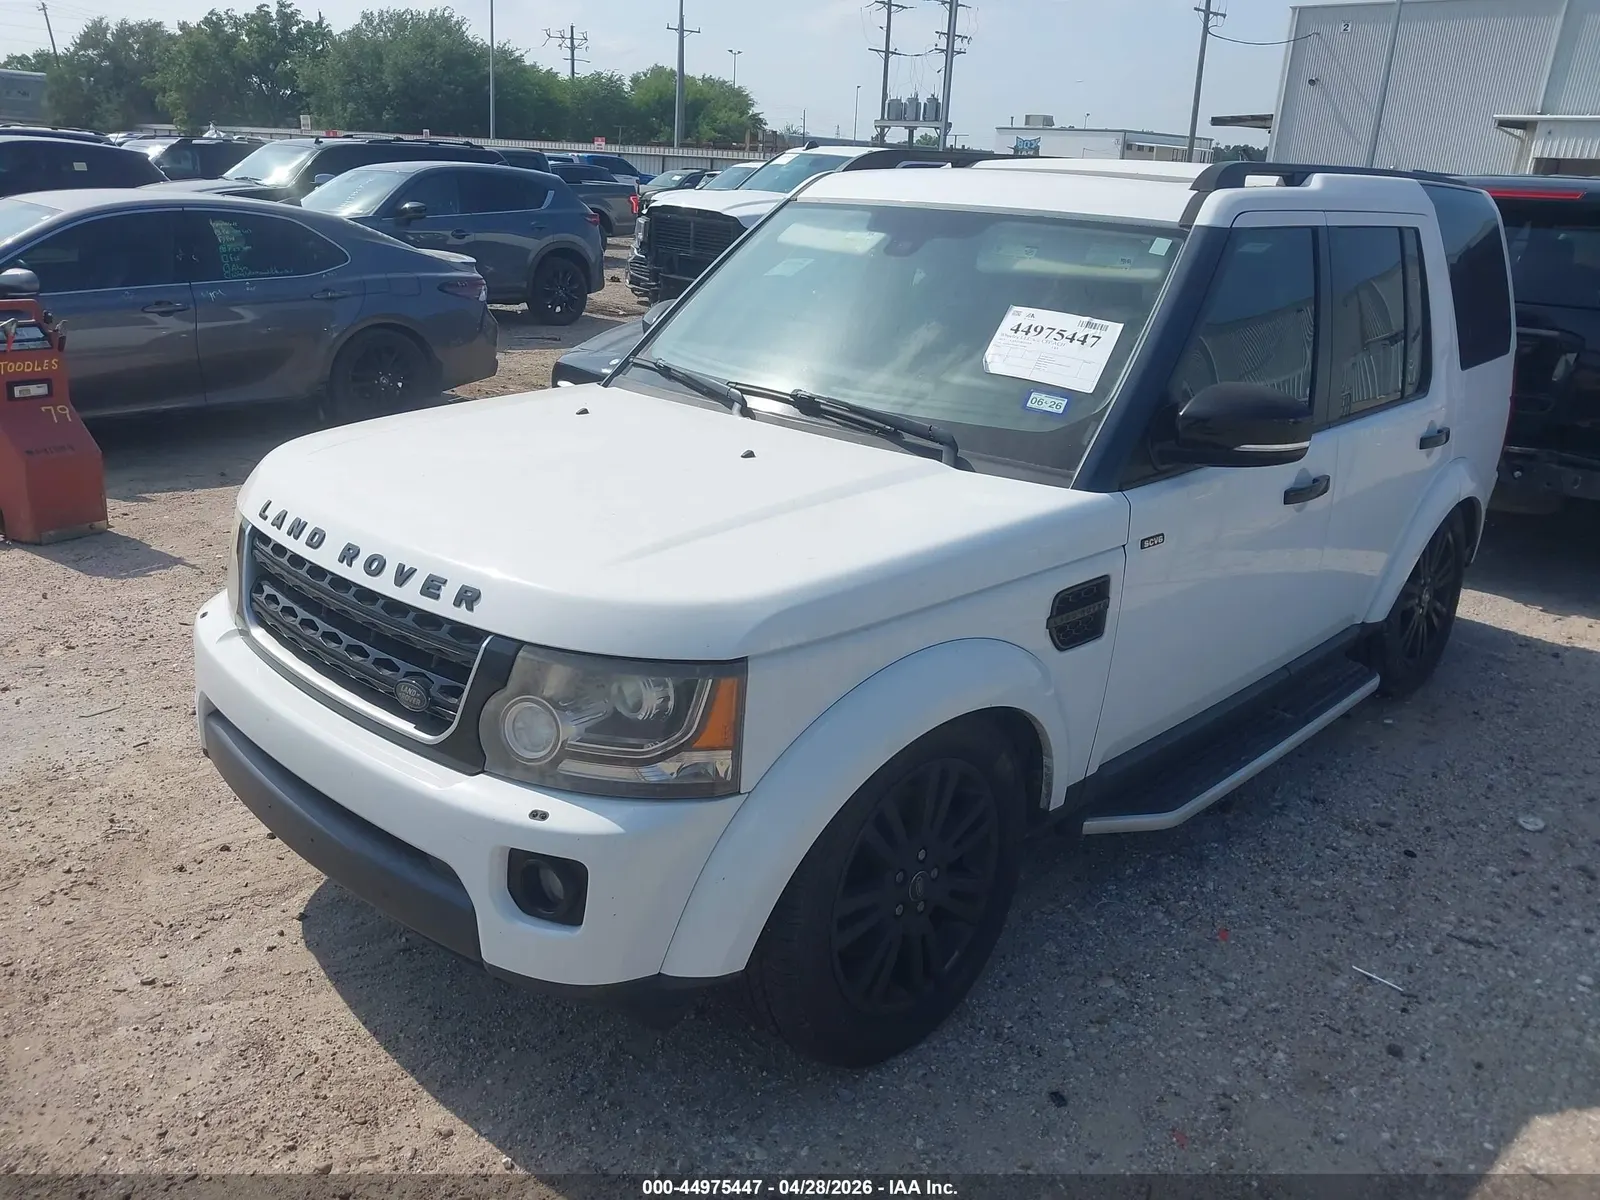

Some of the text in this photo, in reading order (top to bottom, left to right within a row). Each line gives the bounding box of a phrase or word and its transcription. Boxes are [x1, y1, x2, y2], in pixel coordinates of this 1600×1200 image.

[1342, 23, 1350, 32] 2
[1010, 322, 1102, 348] 44975447
[0, 358, 58, 375] TOODLES
[41, 404, 72, 423] 79
[258, 499, 483, 613] LAND ROVER
[398, 692, 421, 706] ROVER
[400, 684, 417, 697] LAND
